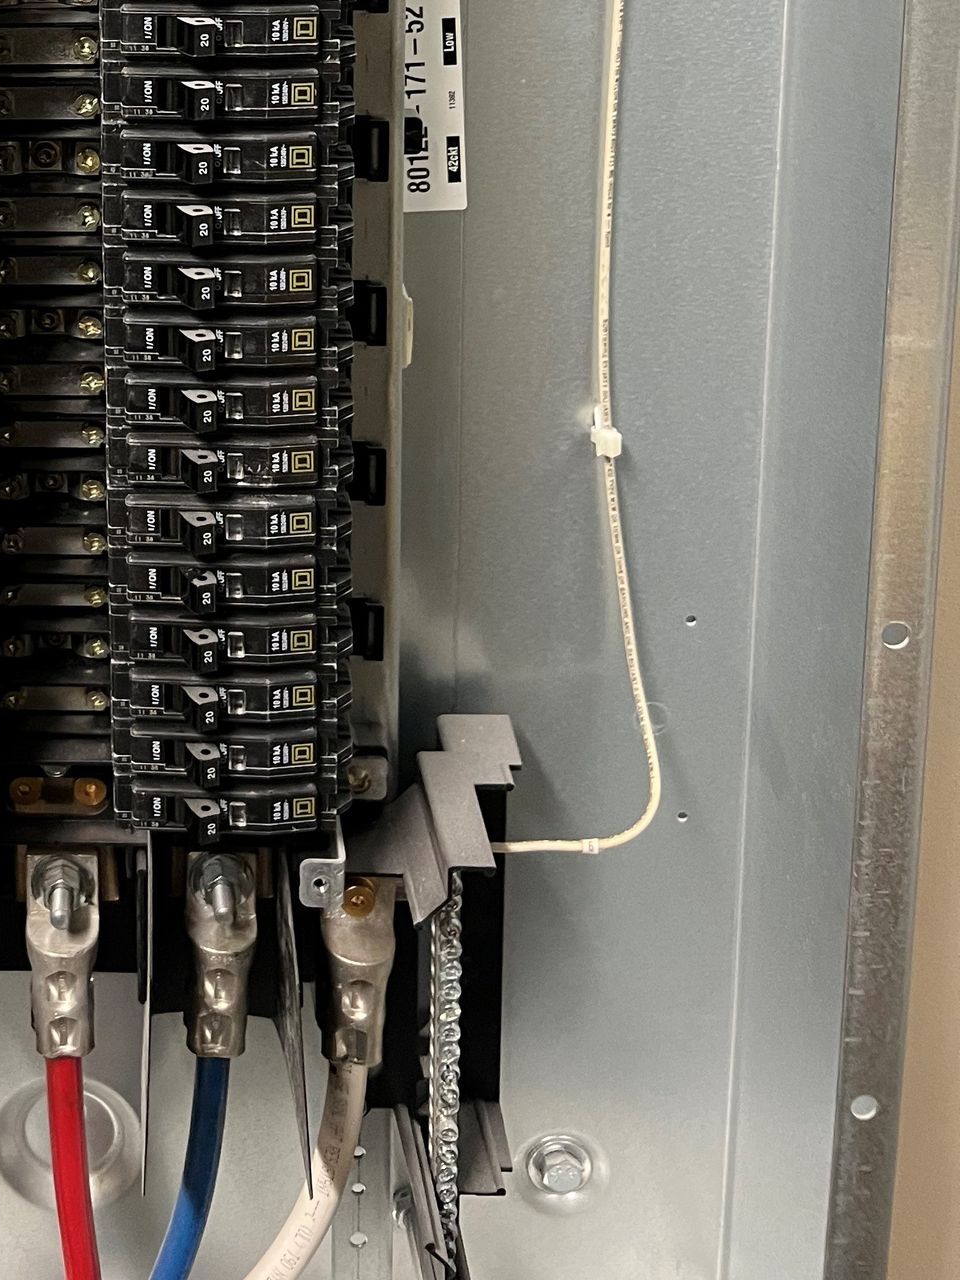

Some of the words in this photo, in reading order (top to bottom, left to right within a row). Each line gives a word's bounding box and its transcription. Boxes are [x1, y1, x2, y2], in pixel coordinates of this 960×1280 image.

[144, 17, 152, 38] I/ON
[201, 34, 209, 47] 20
[444, 33, 454, 51] Low
[201, 98, 209, 111] 20
[143, 143, 151, 164] I/ON
[448, 147, 458, 172] 42ckt
[199, 162, 207, 174] 20
[200, 224, 208, 236] 20
[202, 287, 210, 299] 20
[203, 349, 211, 361] 20
[204, 411, 211, 423] 20
[204, 471, 212, 482] 20
[203, 533, 211, 545] 20
[203, 593, 210, 604] 20
[204, 651, 212, 663] 20
[206, 711, 214, 723] 20
[207, 768, 215, 779] 20
[207, 823, 216, 835] 20
